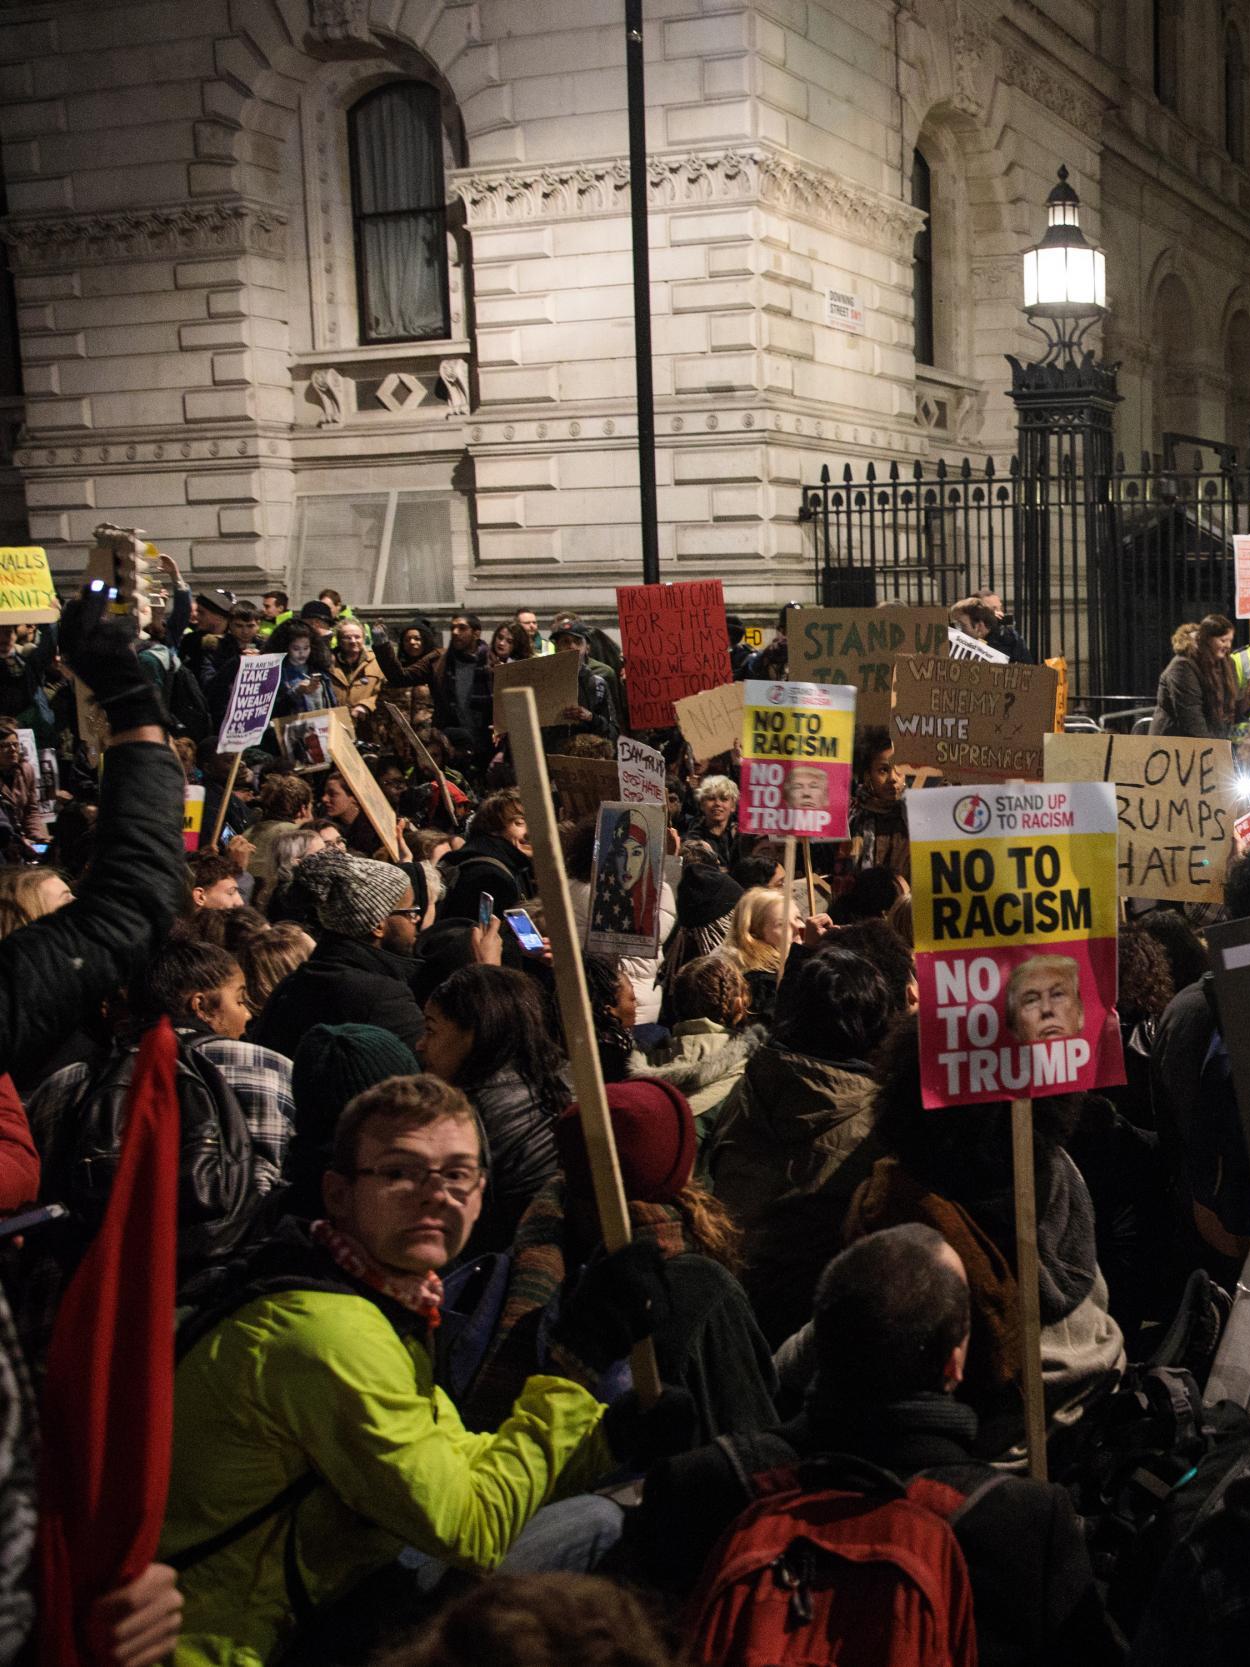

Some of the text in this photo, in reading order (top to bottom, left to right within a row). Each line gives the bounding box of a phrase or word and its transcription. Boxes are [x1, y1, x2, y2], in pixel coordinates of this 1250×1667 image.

[618, 581, 722, 613] FIRST THEY CAME
[624, 608, 713, 635] FOR THE
[627, 628, 729, 657] MUSLIMS
[804, 621, 906, 660] STAND
[914, 625, 949, 656] UP
[241, 669, 270, 683] TAKE
[629, 652, 727, 677] AND WE SAID
[239, 682, 262, 696] THE
[631, 671, 731, 700] NOT TODAY
[990, 666, 1033, 690] THE
[233, 704, 270, 722] OFF THE
[237, 692, 273, 709] WEALTH
[930, 686, 1016, 719] ENEMY?
[753, 711, 821, 735] NO TO
[895, 714, 969, 740] WHITE
[619, 741, 644, 765] BAN
[752, 732, 838, 758] RACISM
[749, 763, 785, 787] NO
[1104, 735, 1216, 795] LOVE
[641, 780, 663, 801] HATE
[748, 786, 782, 808] TO
[995, 794, 1066, 812] STAND UP
[747, 807, 832, 833] TRUMP
[996, 811, 1075, 830] TO RACISM
[1117, 795, 1226, 841] RUMPS
[930, 845, 1060, 895] NO TO
[933, 888, 1092, 940] RACISM
[934, 957, 1001, 1006] NO
[936, 1004, 999, 1050] TO
[938, 1037, 1091, 1096] TRUMP
